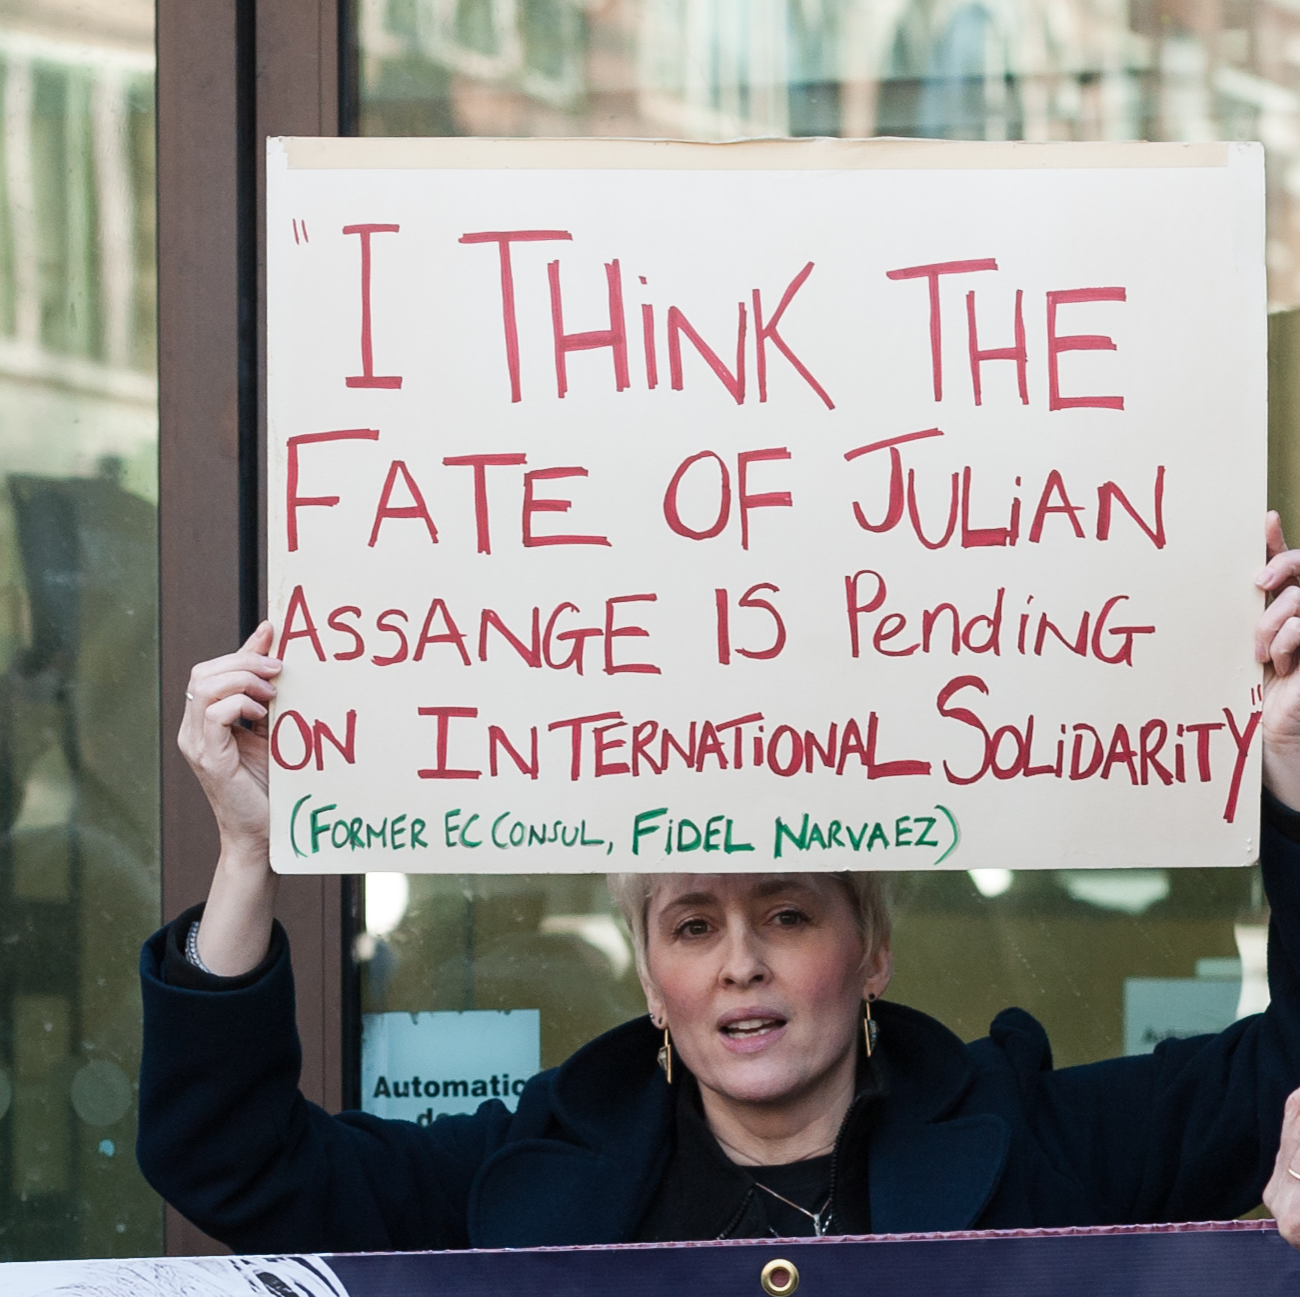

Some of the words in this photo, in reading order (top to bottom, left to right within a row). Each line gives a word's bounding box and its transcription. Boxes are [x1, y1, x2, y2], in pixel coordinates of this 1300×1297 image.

[887, 259, 1126, 410] THE
[286, 429, 610, 554] FATE
[663, 447, 792, 549] OF
[277, 586, 660, 674] ASSANGE
[716, 583, 786, 664] IS
[270, 708, 357, 770] ON
[290, 794, 428, 857] (FORMER
[445, 808, 483, 848] EC
[491, 812, 614, 856] CONSUL,
[774, 805, 960, 864] NARVAEZ)
